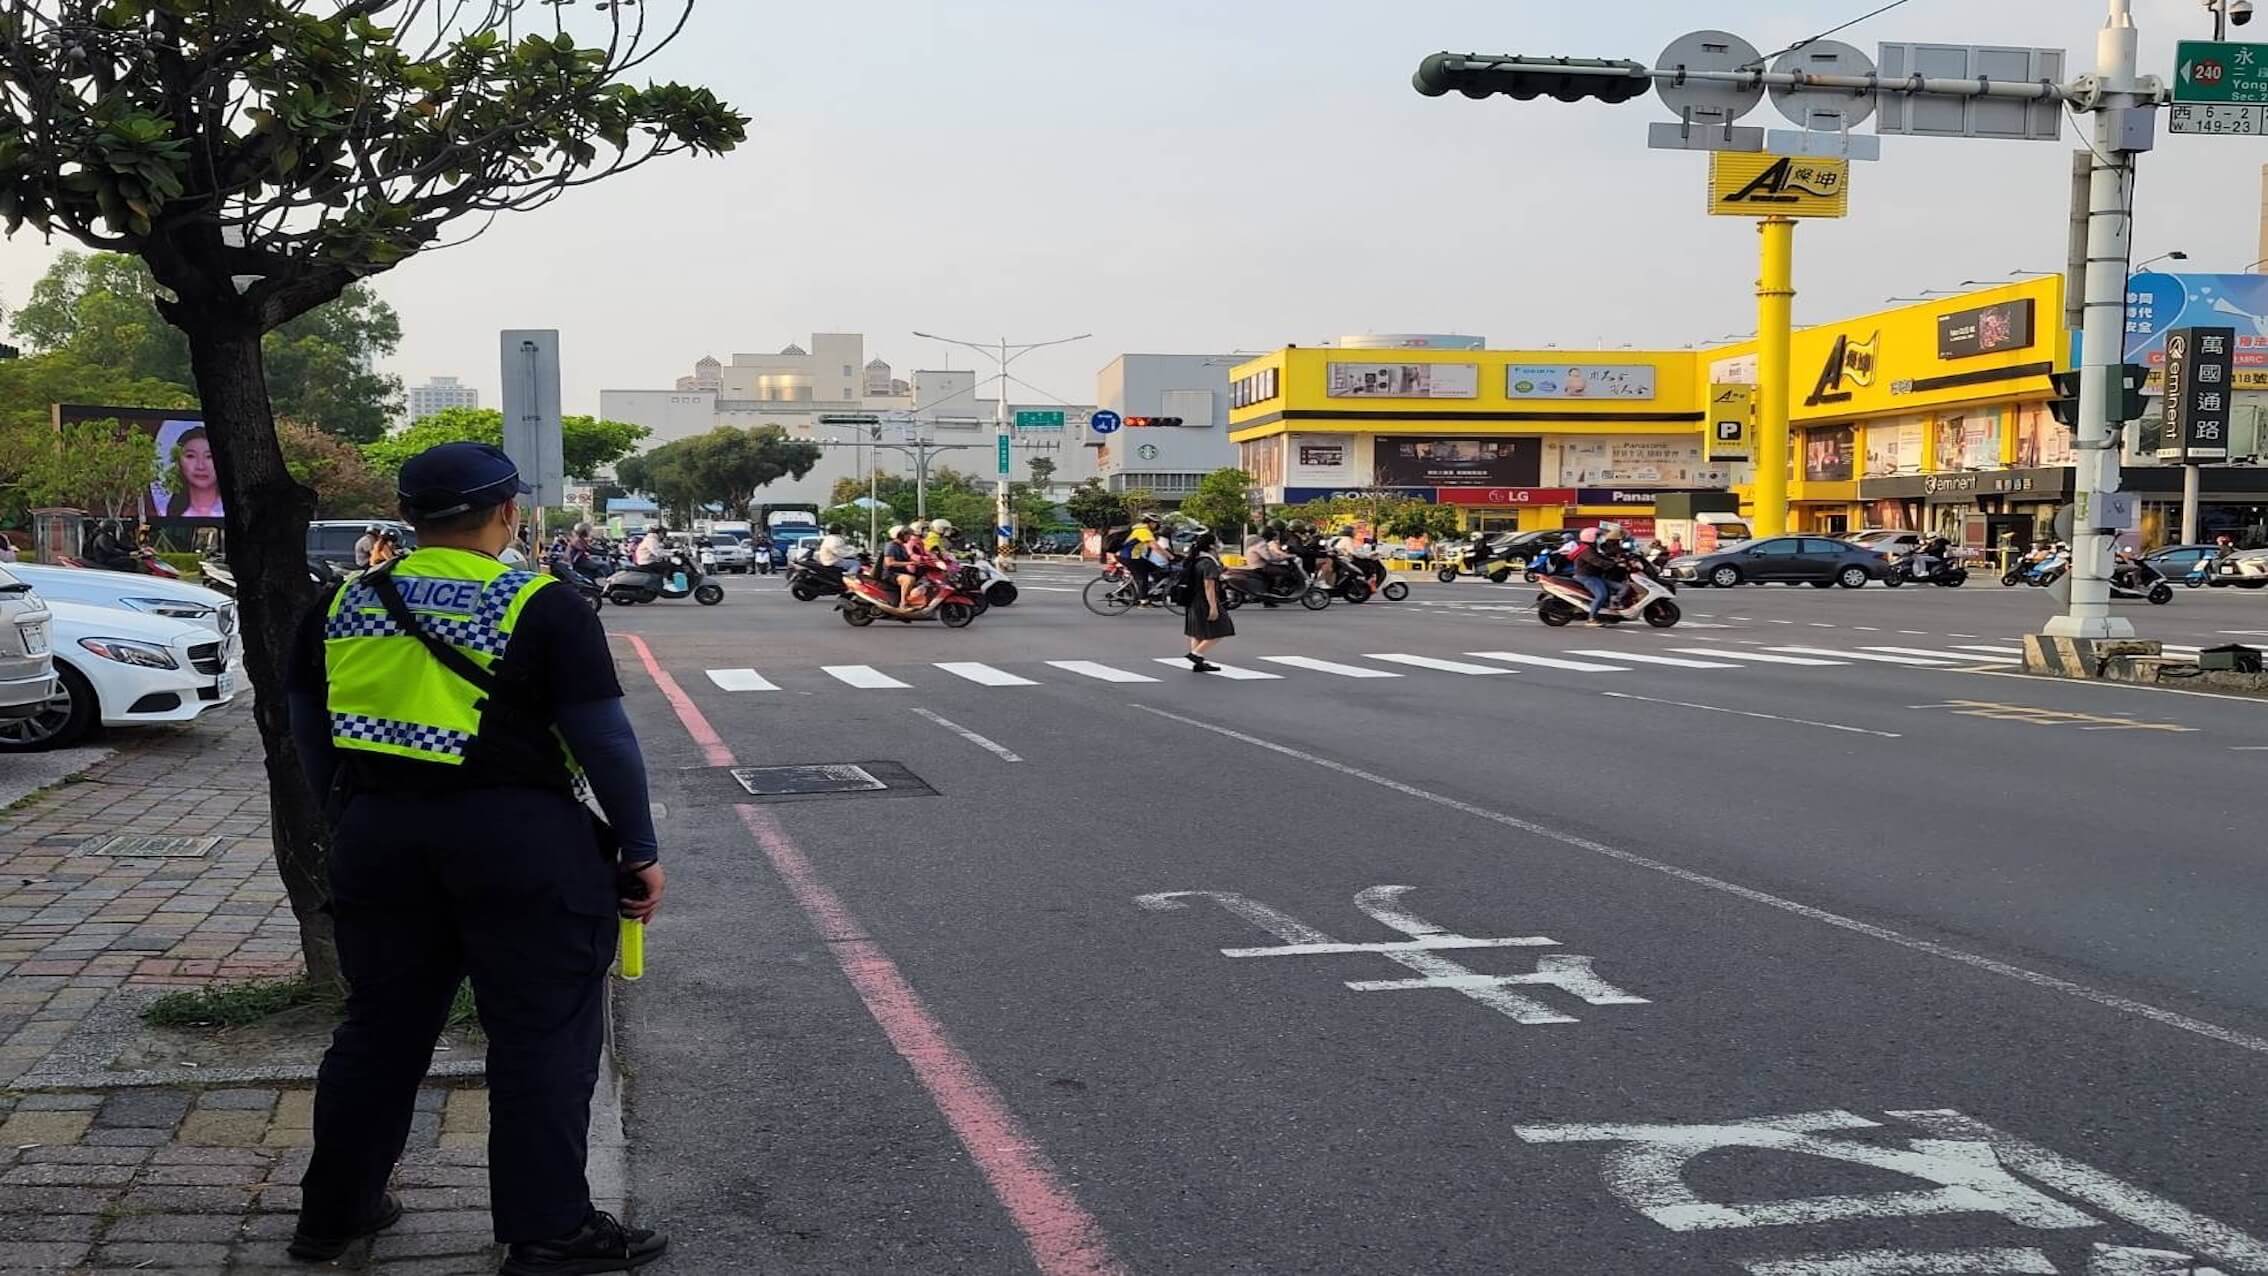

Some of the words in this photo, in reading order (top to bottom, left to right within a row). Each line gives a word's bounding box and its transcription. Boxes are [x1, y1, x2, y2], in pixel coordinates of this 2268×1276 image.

[2233, 46, 2255, 65] 永
[2194, 65, 2222, 80] 240
[2173, 105, 2192, 120] 西
[2196, 120, 2250, 133] 149-23
[2195, 335, 2225, 441] 萬國通路
[2165, 362, 2180, 439] eminent
[1720, 422, 1738, 439] P
[1937, 474, 1978, 492] eminent
[1508, 490, 1530, 503] LG
